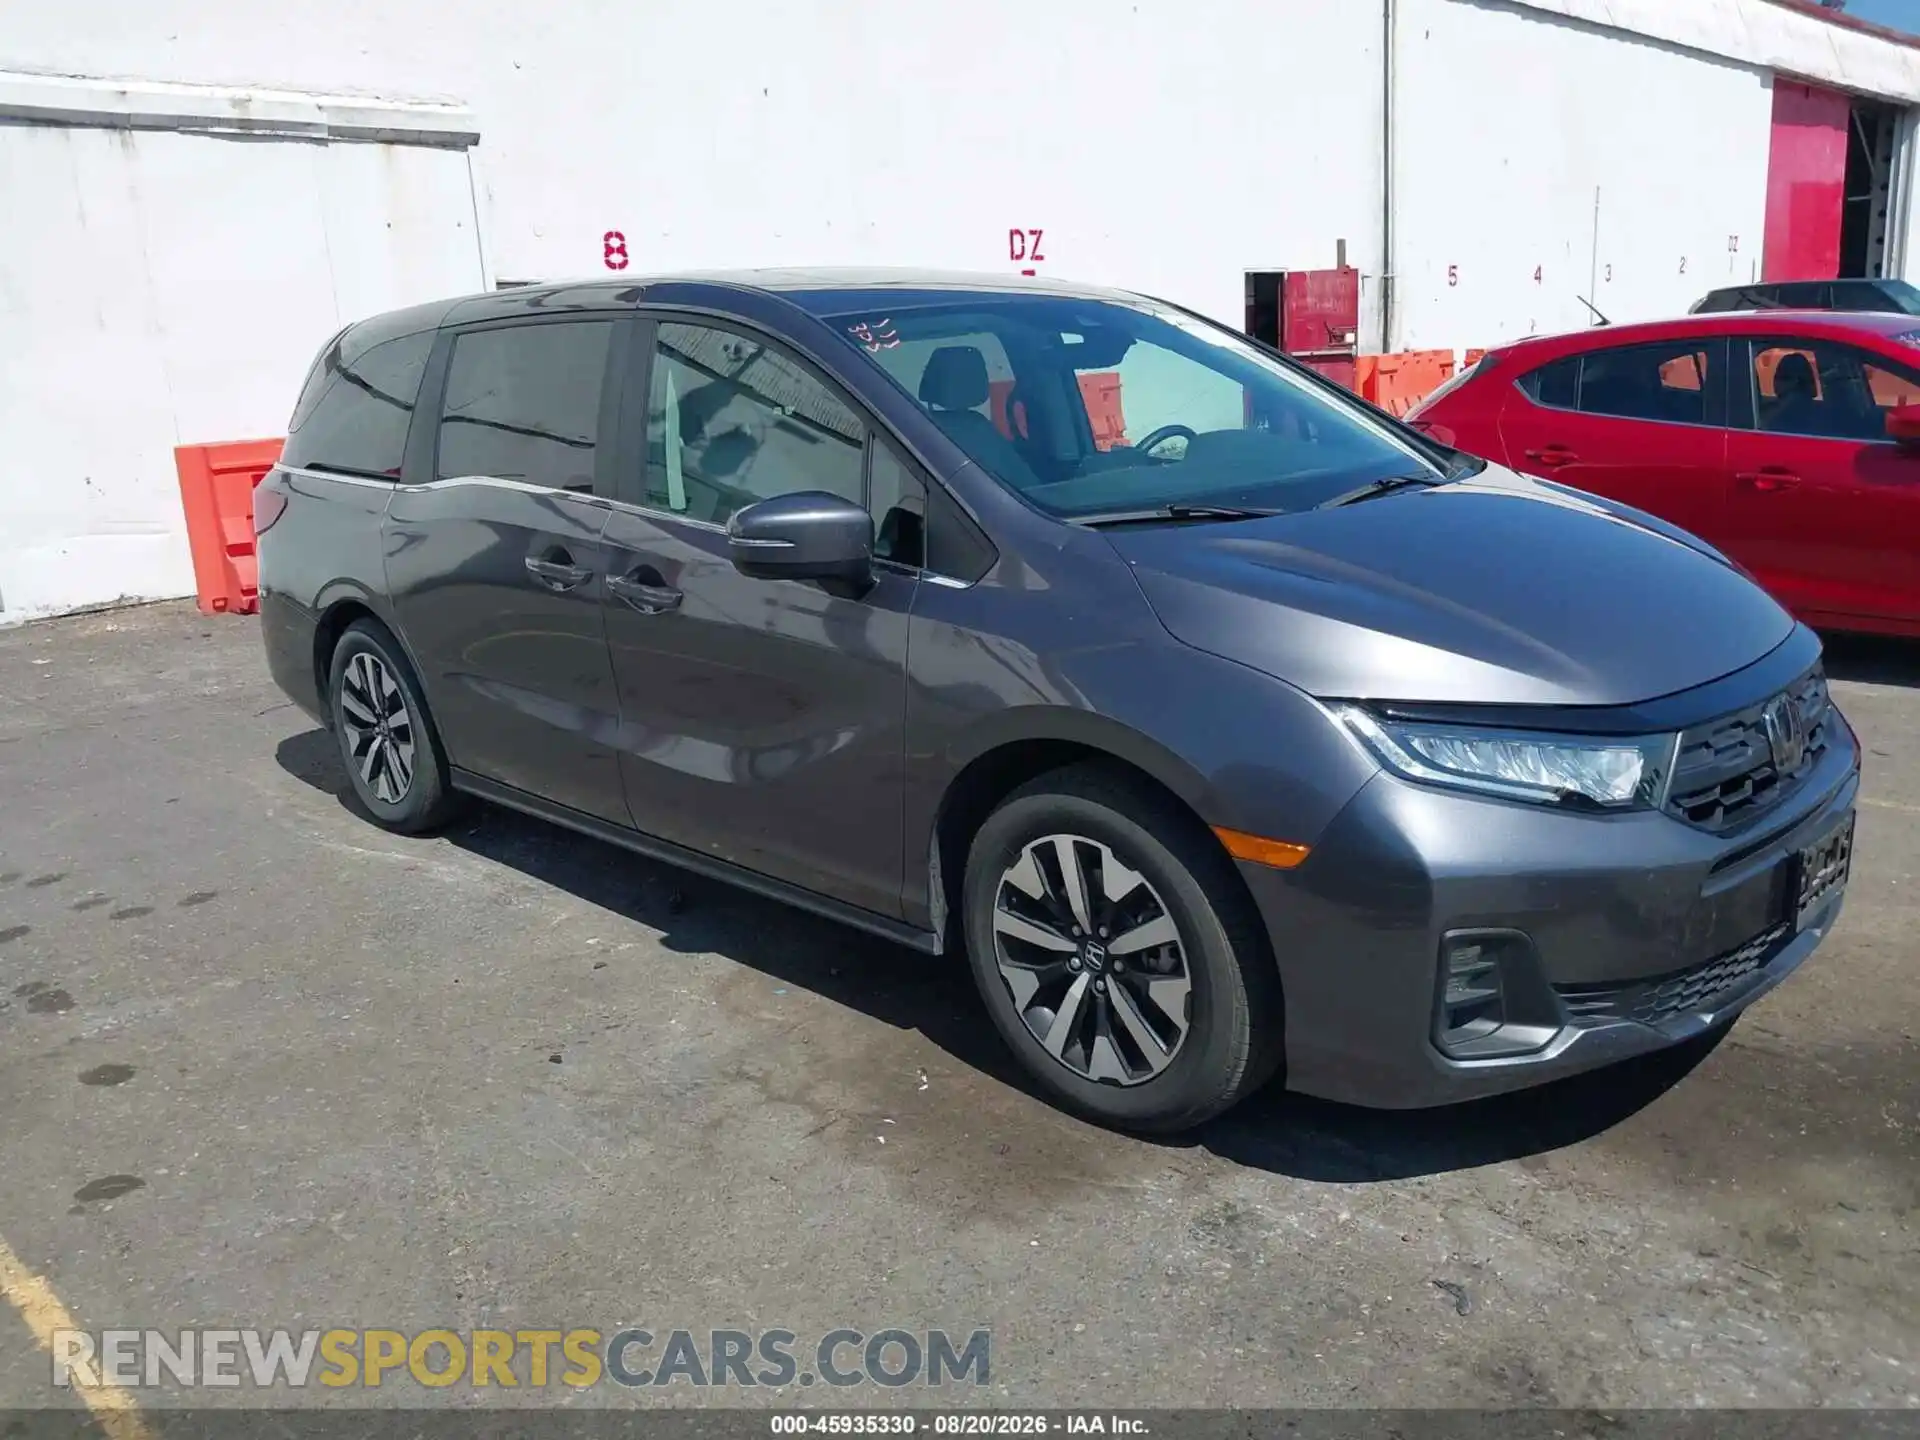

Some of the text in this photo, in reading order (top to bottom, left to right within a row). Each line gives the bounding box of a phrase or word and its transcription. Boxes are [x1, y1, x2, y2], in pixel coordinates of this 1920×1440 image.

[602, 230, 630, 271] 8
[1447, 264, 1460, 287] 5
[1533, 264, 1543, 286] 4
[1604, 263, 1613, 283] 3
[1679, 255, 1687, 275] 2
